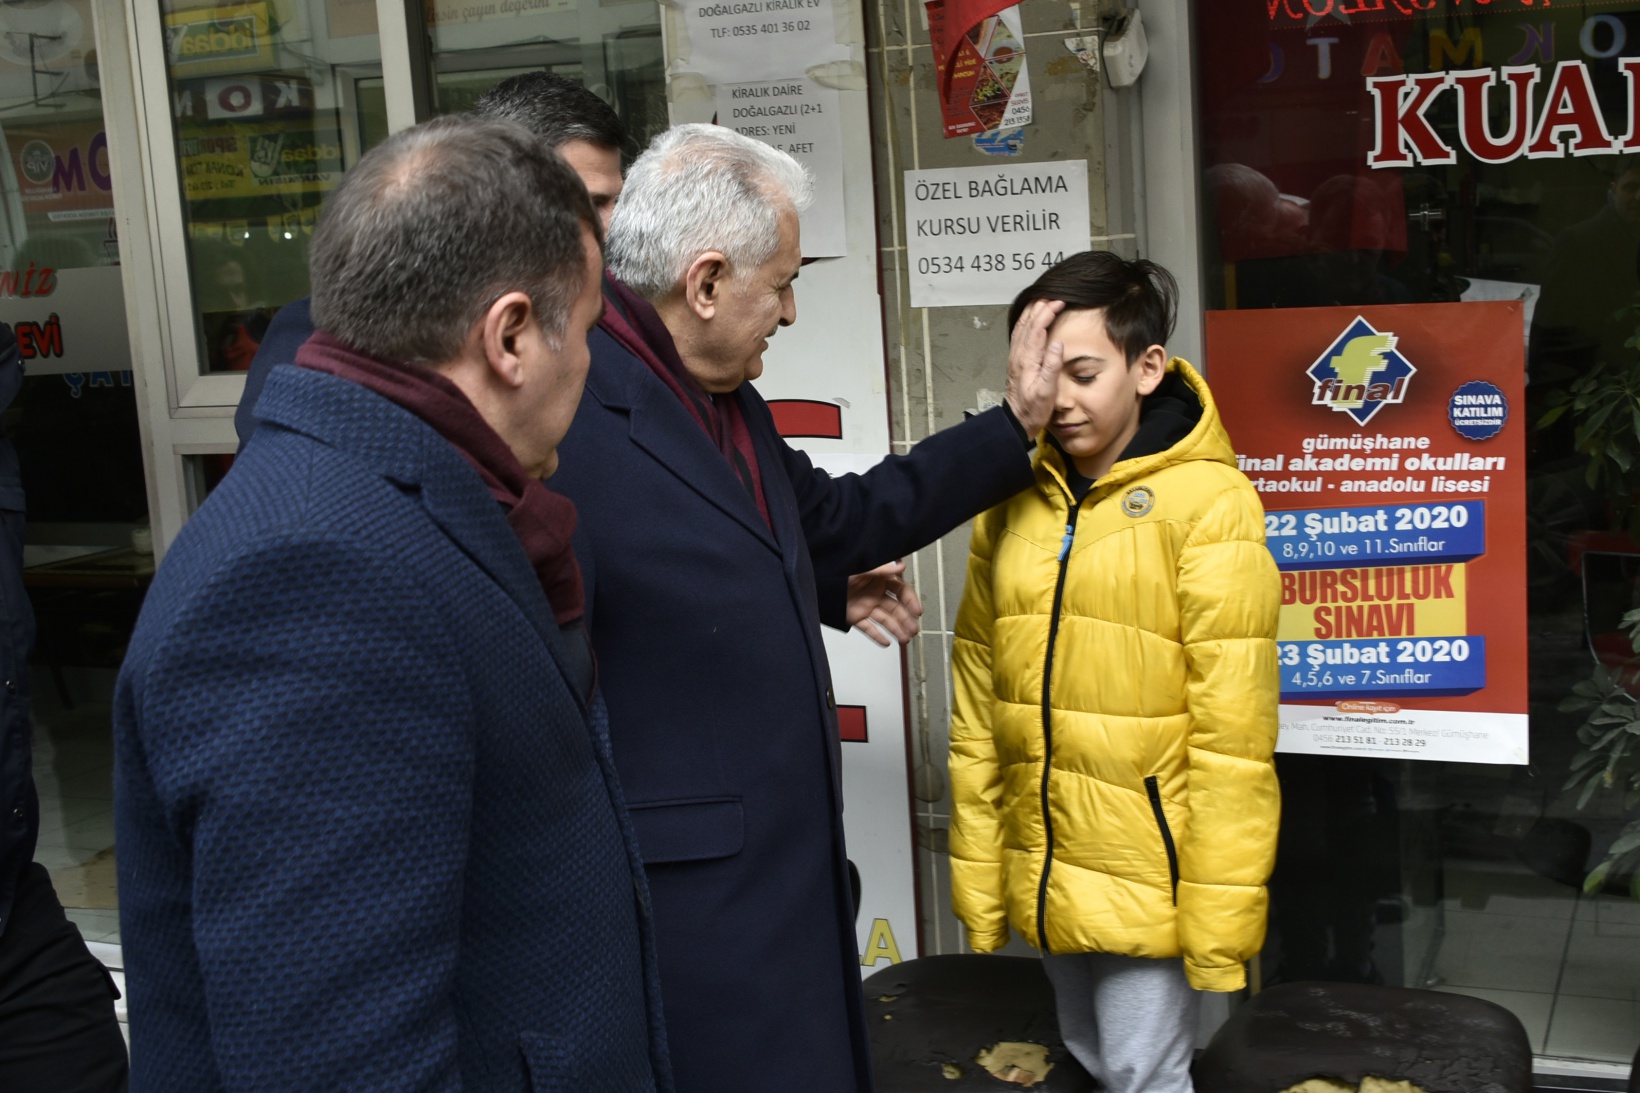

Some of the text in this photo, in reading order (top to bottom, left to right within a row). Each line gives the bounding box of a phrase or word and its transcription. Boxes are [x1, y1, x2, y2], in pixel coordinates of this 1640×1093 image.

[699, 2, 763, 18] DOĞALGAZLI
[710, 20, 811, 38] TLF: 0535 401 36 02
[732, 83, 803, 99] KİRALIK DAİRE
[733, 103, 822, 118] DOĞALGAZLI (2+1
[1012, 106, 1030, 114] 0456
[772, 121, 796, 135] YENİ
[1004, 116, 1015, 126] 213
[788, 142, 814, 154] AFET
[914, 173, 1068, 201] ÖZEL BAĞLAMA
[917, 208, 1061, 237] KURSU VERİLİR
[918, 251, 1064, 275] 0534 438 56 44
[1317, 377, 1406, 402] final
[1454, 394, 1502, 406] SINAVA
[1453, 406, 1504, 418] KATILIM
[1302, 433, 1431, 454] gümüşhane
[1288, 453, 1400, 471] akademi
[1404, 453, 1506, 471] okulları
[1340, 476, 1427, 493] anadolu
[1431, 476, 1491, 493] lisesi
[1265, 504, 1469, 541] 22 Şubat 2020
[1282, 536, 1446, 560] 8,9,10 ve 11.Sınıflar
[1281, 564, 1455, 606] BURSLULUK
[1313, 602, 1415, 640] SINAVI
[1306, 641, 1391, 671] Şubat
[1396, 639, 1470, 663] 2020
[1291, 668, 1432, 688] 4,5,6 ve 7.Sınıflar
[1335, 735, 1351, 743] 213
[1353, 736, 1364, 744] 51
[1366, 736, 1377, 745] 81
[1383, 737, 1400, 746] 213
[1402, 738, 1413, 747] 28
[1415, 739, 1427, 747] 29
[859, 918, 903, 967] A
